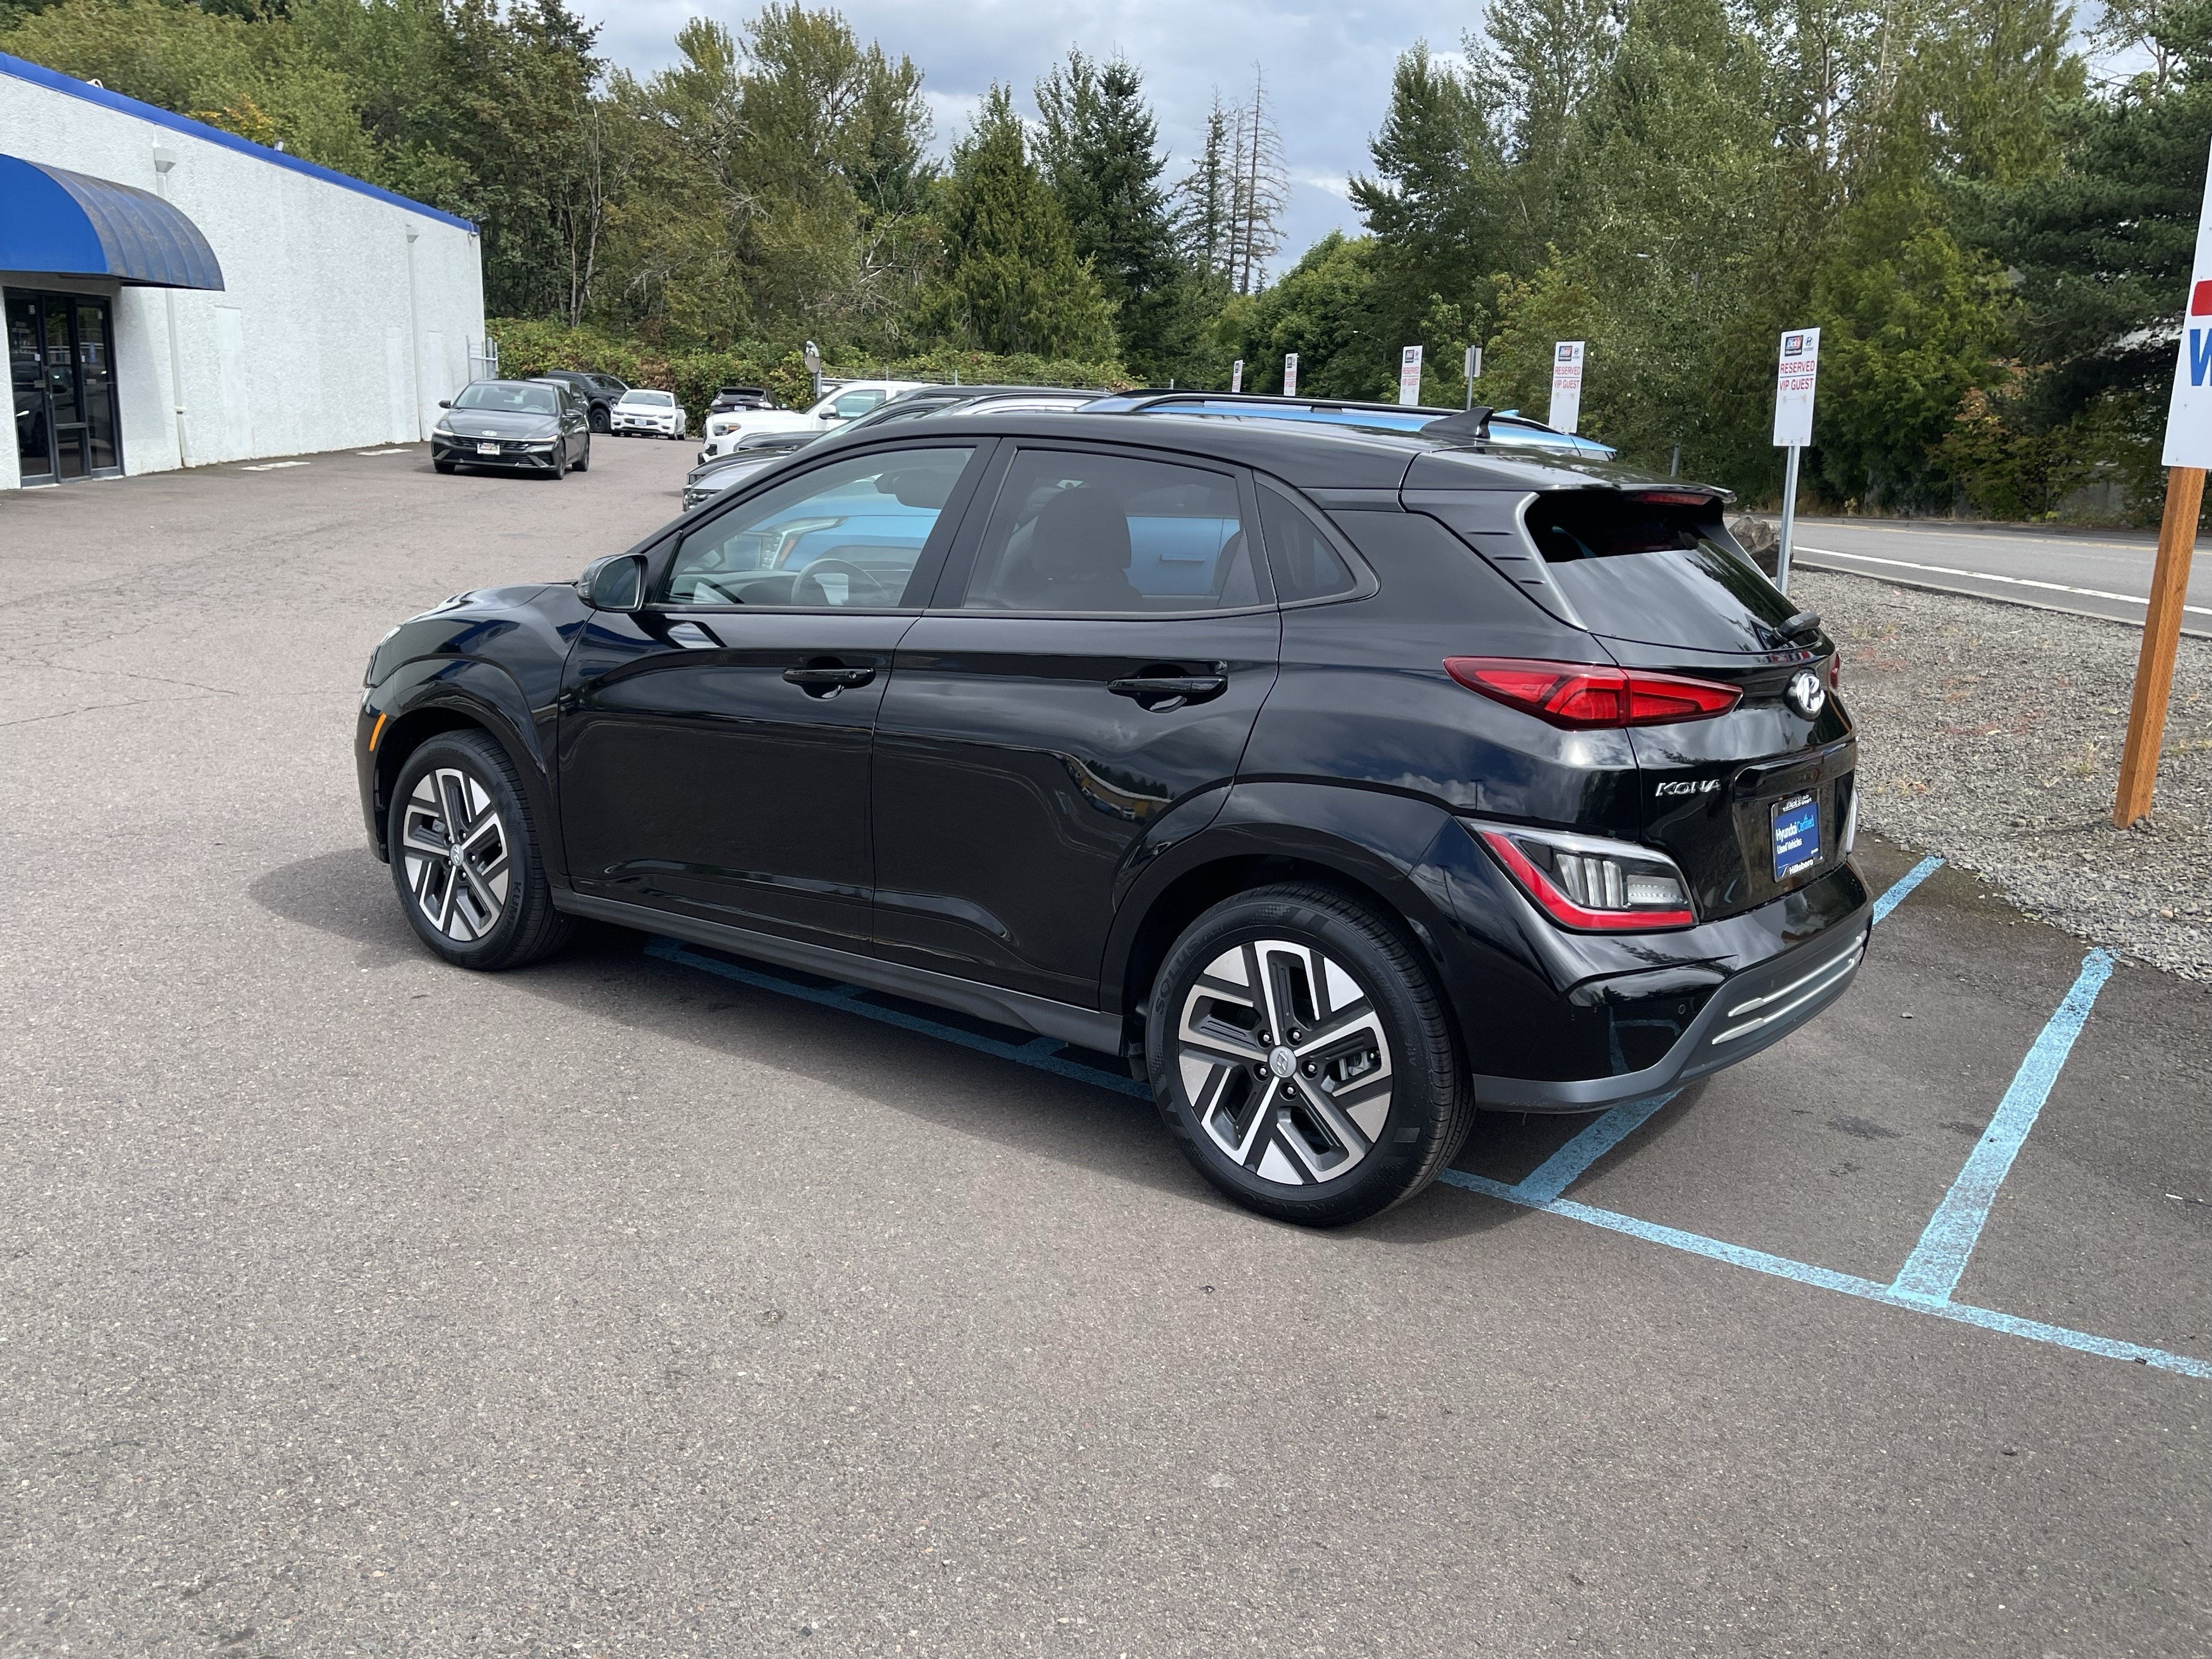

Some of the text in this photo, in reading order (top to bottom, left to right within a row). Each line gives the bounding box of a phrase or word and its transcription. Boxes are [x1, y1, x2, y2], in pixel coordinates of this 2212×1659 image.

[1555, 366, 1581, 375] RESERVED
[1780, 360, 1815, 374] RESERVED
[1554, 380, 1580, 388] VIP GUEST
[1779, 378, 1814, 391] VIP GUEST
[1655, 779, 1722, 797] KONA
[1775, 821, 1798, 843] Hyundai
[1776, 838, 1802, 855] Used Vehicles
[1789, 859, 1814, 875] Hillsboro
